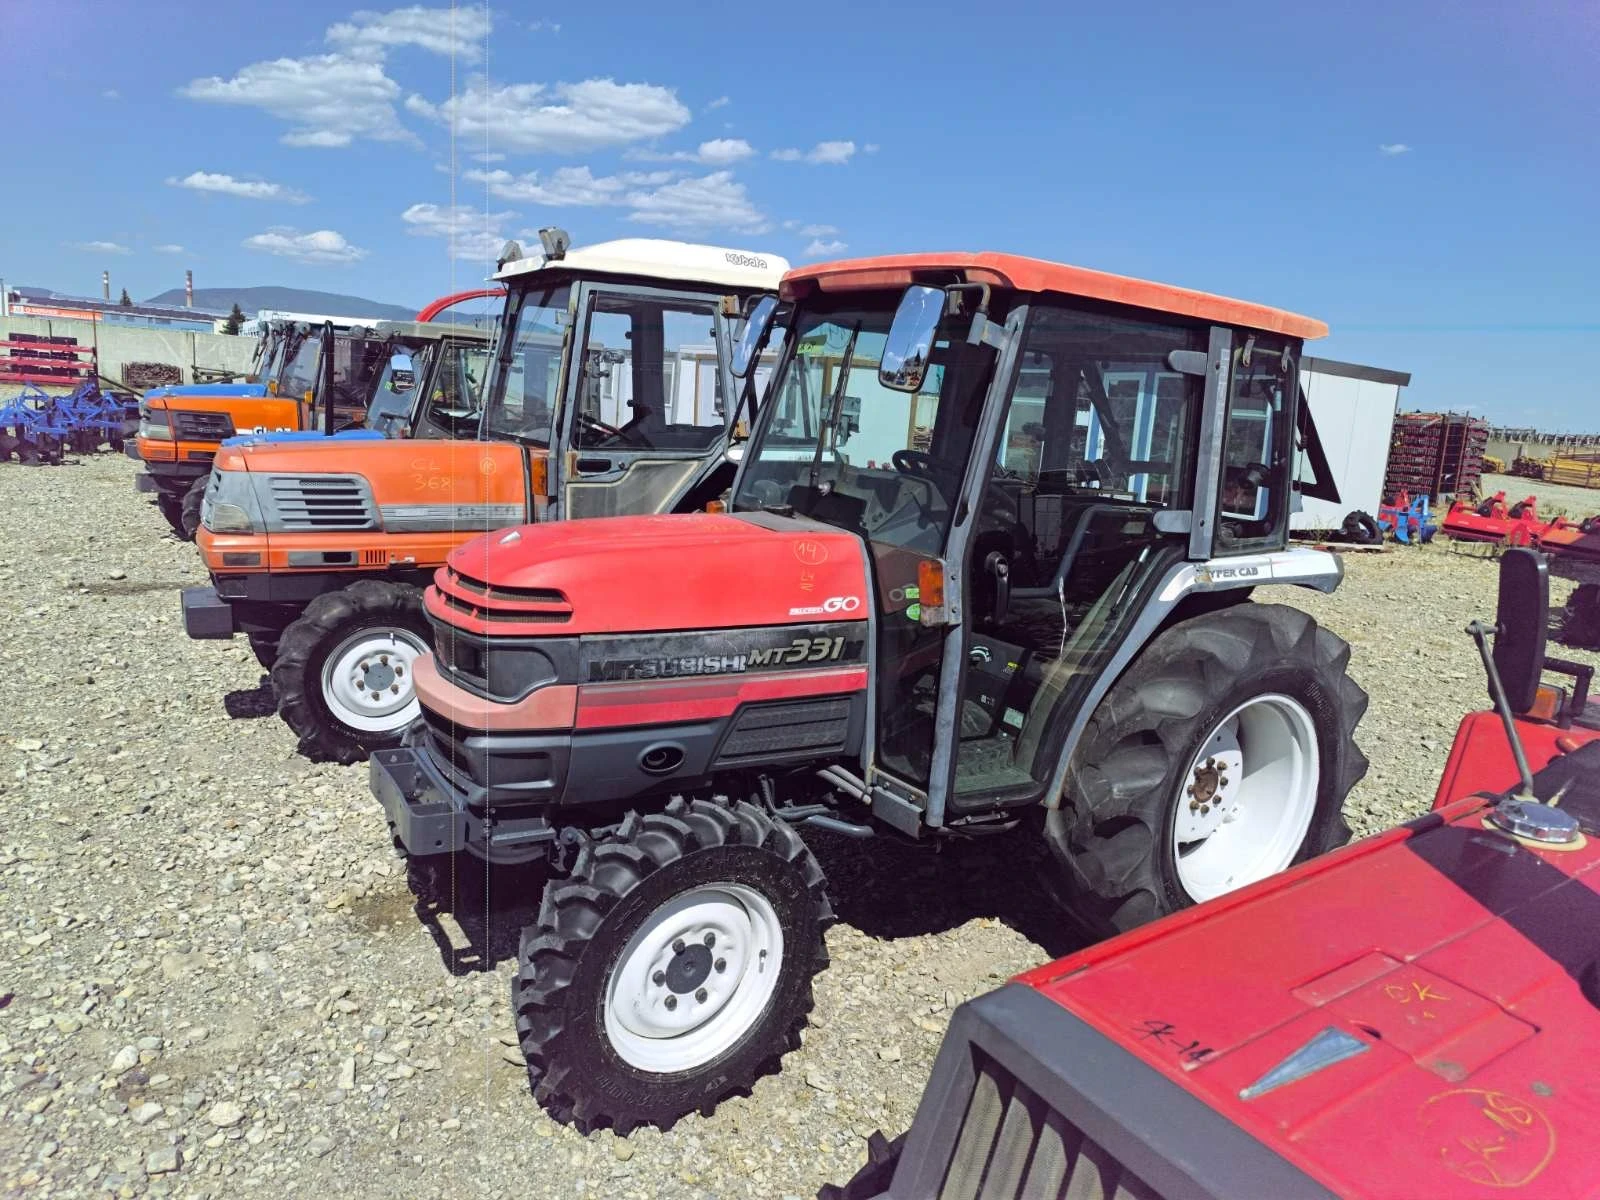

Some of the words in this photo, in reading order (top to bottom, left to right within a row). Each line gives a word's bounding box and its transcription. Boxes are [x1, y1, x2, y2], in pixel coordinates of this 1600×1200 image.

[725, 252, 768, 270] Kubota
[798, 542, 817, 561] 14
[1207, 568, 1238, 579] YPER
[1239, 567, 1259, 578] CAB
[823, 596, 860, 613] GO
[588, 654, 747, 681] MTSUBISHI
[747, 636, 845, 666] MT331
